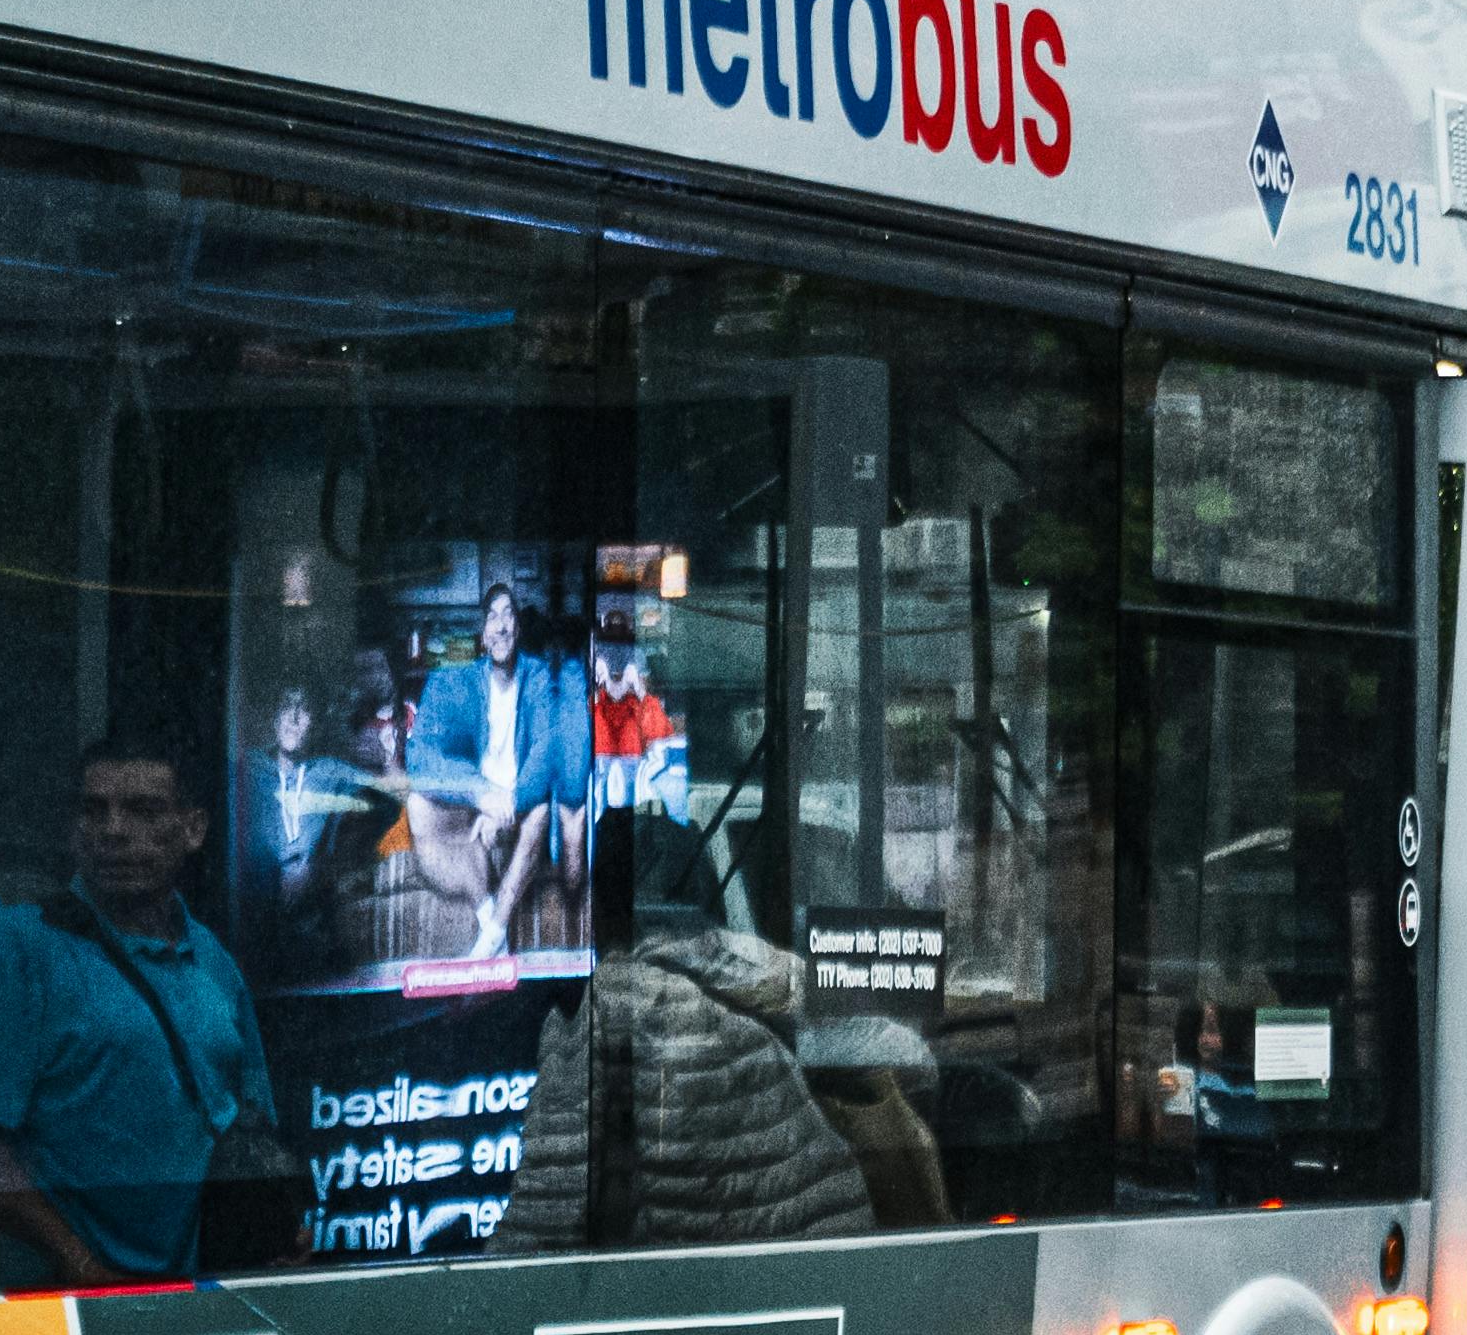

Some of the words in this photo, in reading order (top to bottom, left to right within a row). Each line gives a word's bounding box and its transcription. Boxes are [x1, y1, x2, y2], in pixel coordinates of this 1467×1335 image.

[1253, 145, 1289, 194] CNG
[1345, 172, 1419, 266] 2831
[809, 928, 855, 953] Customer
[855, 930, 877, 953] Info:
[878, 929, 900, 956] (202)
[901, 930, 942, 956] 637-7000
[817, 963, 836, 988] TTY
[836, 963, 869, 988] Phone:
[870, 963, 893, 990] (202)
